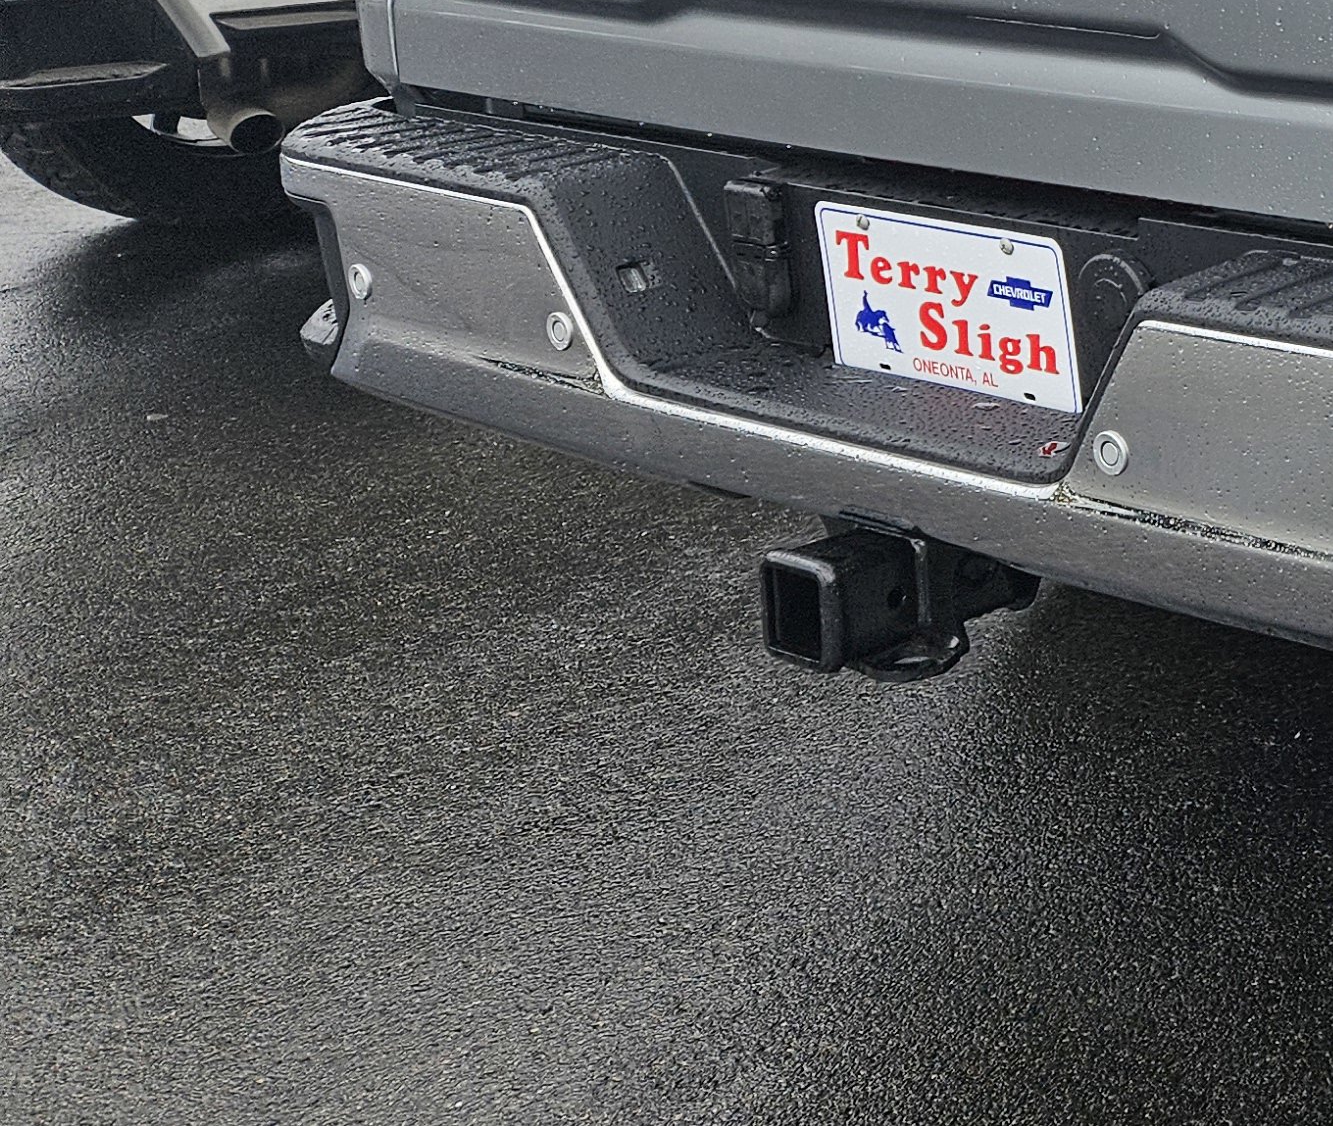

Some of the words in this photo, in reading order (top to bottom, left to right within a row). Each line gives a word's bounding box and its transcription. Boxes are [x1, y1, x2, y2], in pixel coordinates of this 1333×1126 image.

[836, 230, 978, 306] Terry
[992, 282, 1047, 304] CHEVROLET
[919, 301, 1060, 374] Sligh
[913, 357, 977, 386] ONEONTA,
[982, 372, 998, 387] AL
